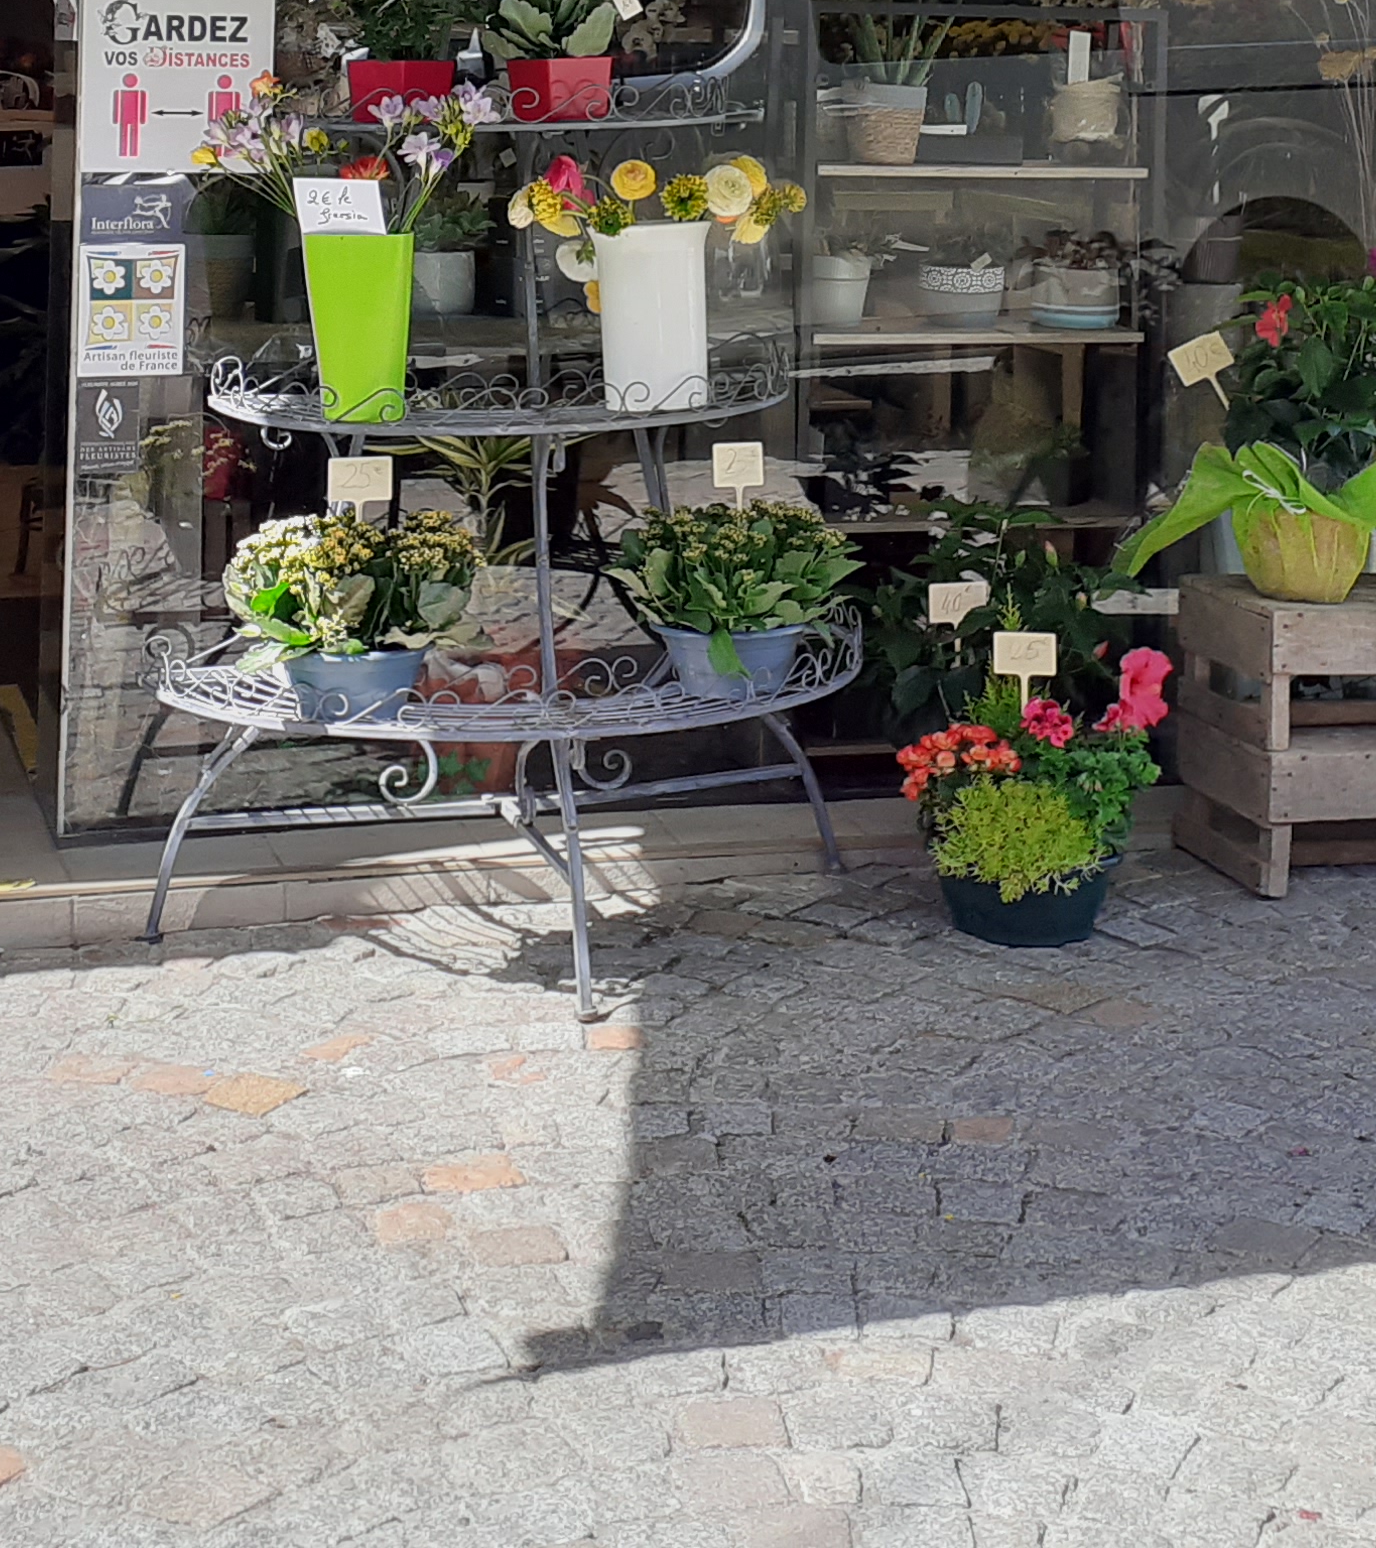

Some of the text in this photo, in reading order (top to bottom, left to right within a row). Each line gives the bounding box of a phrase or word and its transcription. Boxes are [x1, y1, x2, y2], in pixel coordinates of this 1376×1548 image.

[97, 0, 249, 45] GARDEZ
[104, 50, 139, 67] VOS
[91, 216, 155, 230] Interflora
[83, 350, 178, 362] Artisan fleuriste
[120, 360, 178, 371] de France
